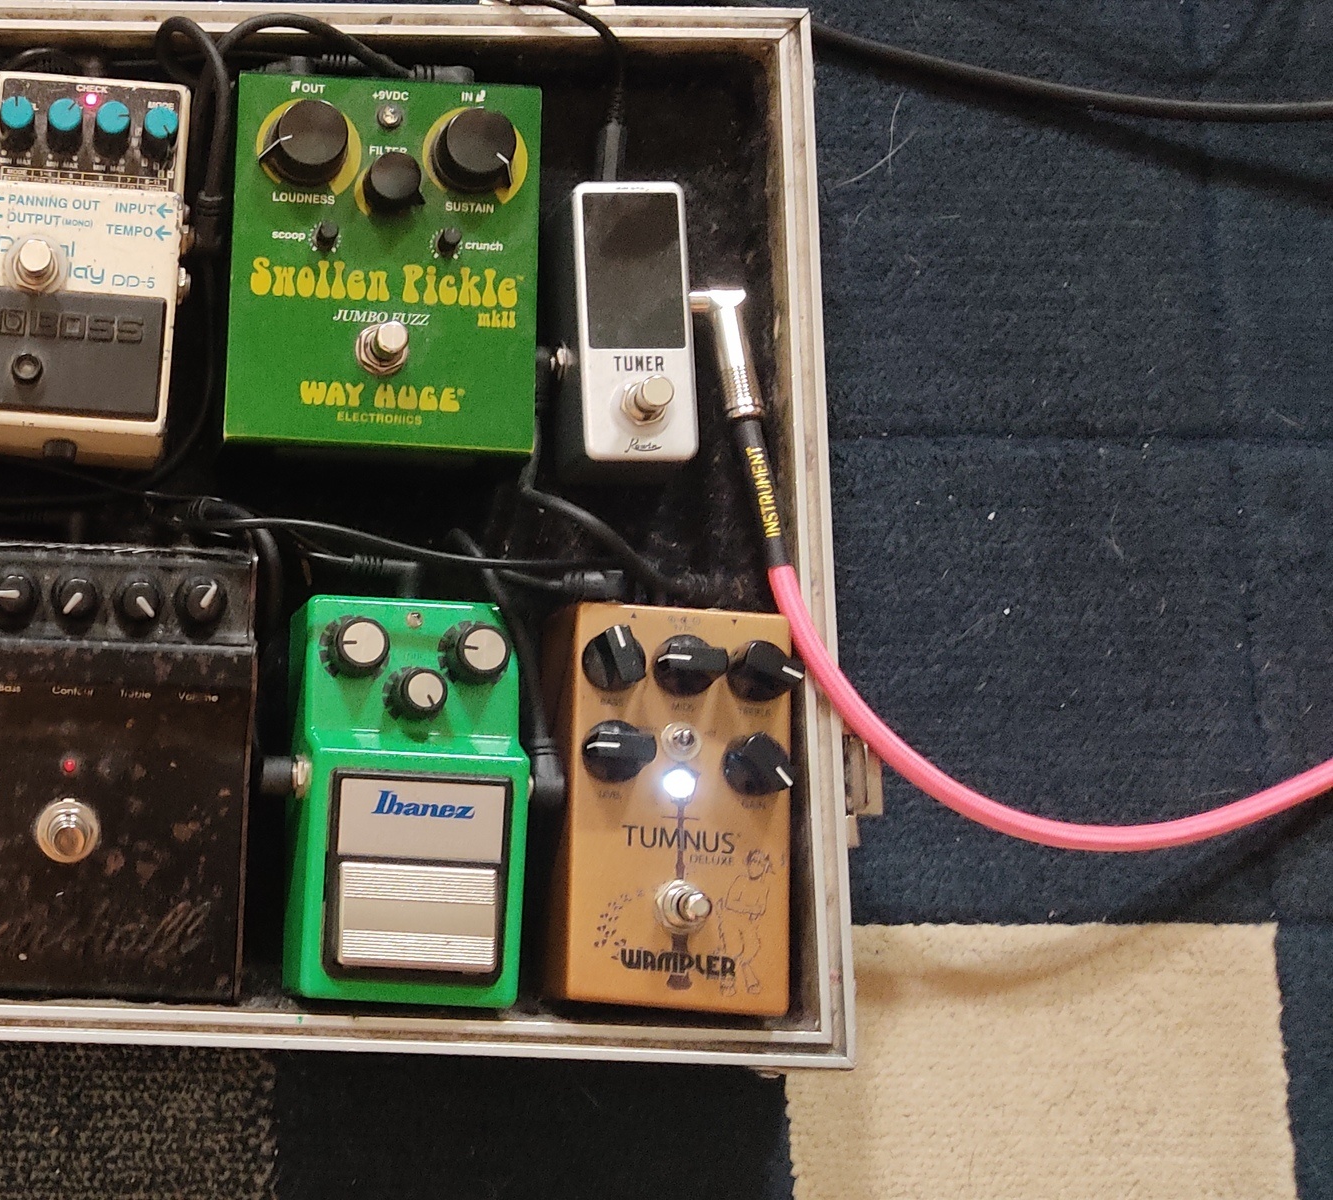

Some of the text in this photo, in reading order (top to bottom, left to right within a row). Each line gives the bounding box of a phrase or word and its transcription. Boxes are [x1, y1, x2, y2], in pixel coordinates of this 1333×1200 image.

[76, 85, 108, 94] CHECK
[301, 84, 325, 94] OUT
[372, 91, 409, 101] +9VDC
[461, 92, 474, 102] IN
[8, 194, 100, 211] PANNING OUT
[272, 191, 335, 205] LOUDNESS
[115, 202, 155, 215] INPUT
[445, 202, 494, 214] SUSTAIN
[8, 212, 61, 226] OUTPUT
[106, 224, 153, 237] TEMPO
[272, 231, 306, 242] scoop
[465, 240, 503, 252] crunch
[112, 274, 155, 288] DD-5
[250, 257, 518, 308] Swollen Pickle
[333, 309, 430, 326] JUMBO FUZZ
[30, 311, 144, 344] BOSS
[613, 356, 665, 372] TUNER
[300, 380, 364, 407] WAY
[337, 412, 423, 425] ELECTRONICS
[746, 446, 781, 538] INSTRUMENT
[370, 790, 475, 820] Ibanez
[622, 824, 736, 854] TUMNUS
[689, 854, 735, 866] DELUXE
[620, 948, 736, 978] WAMPLER
